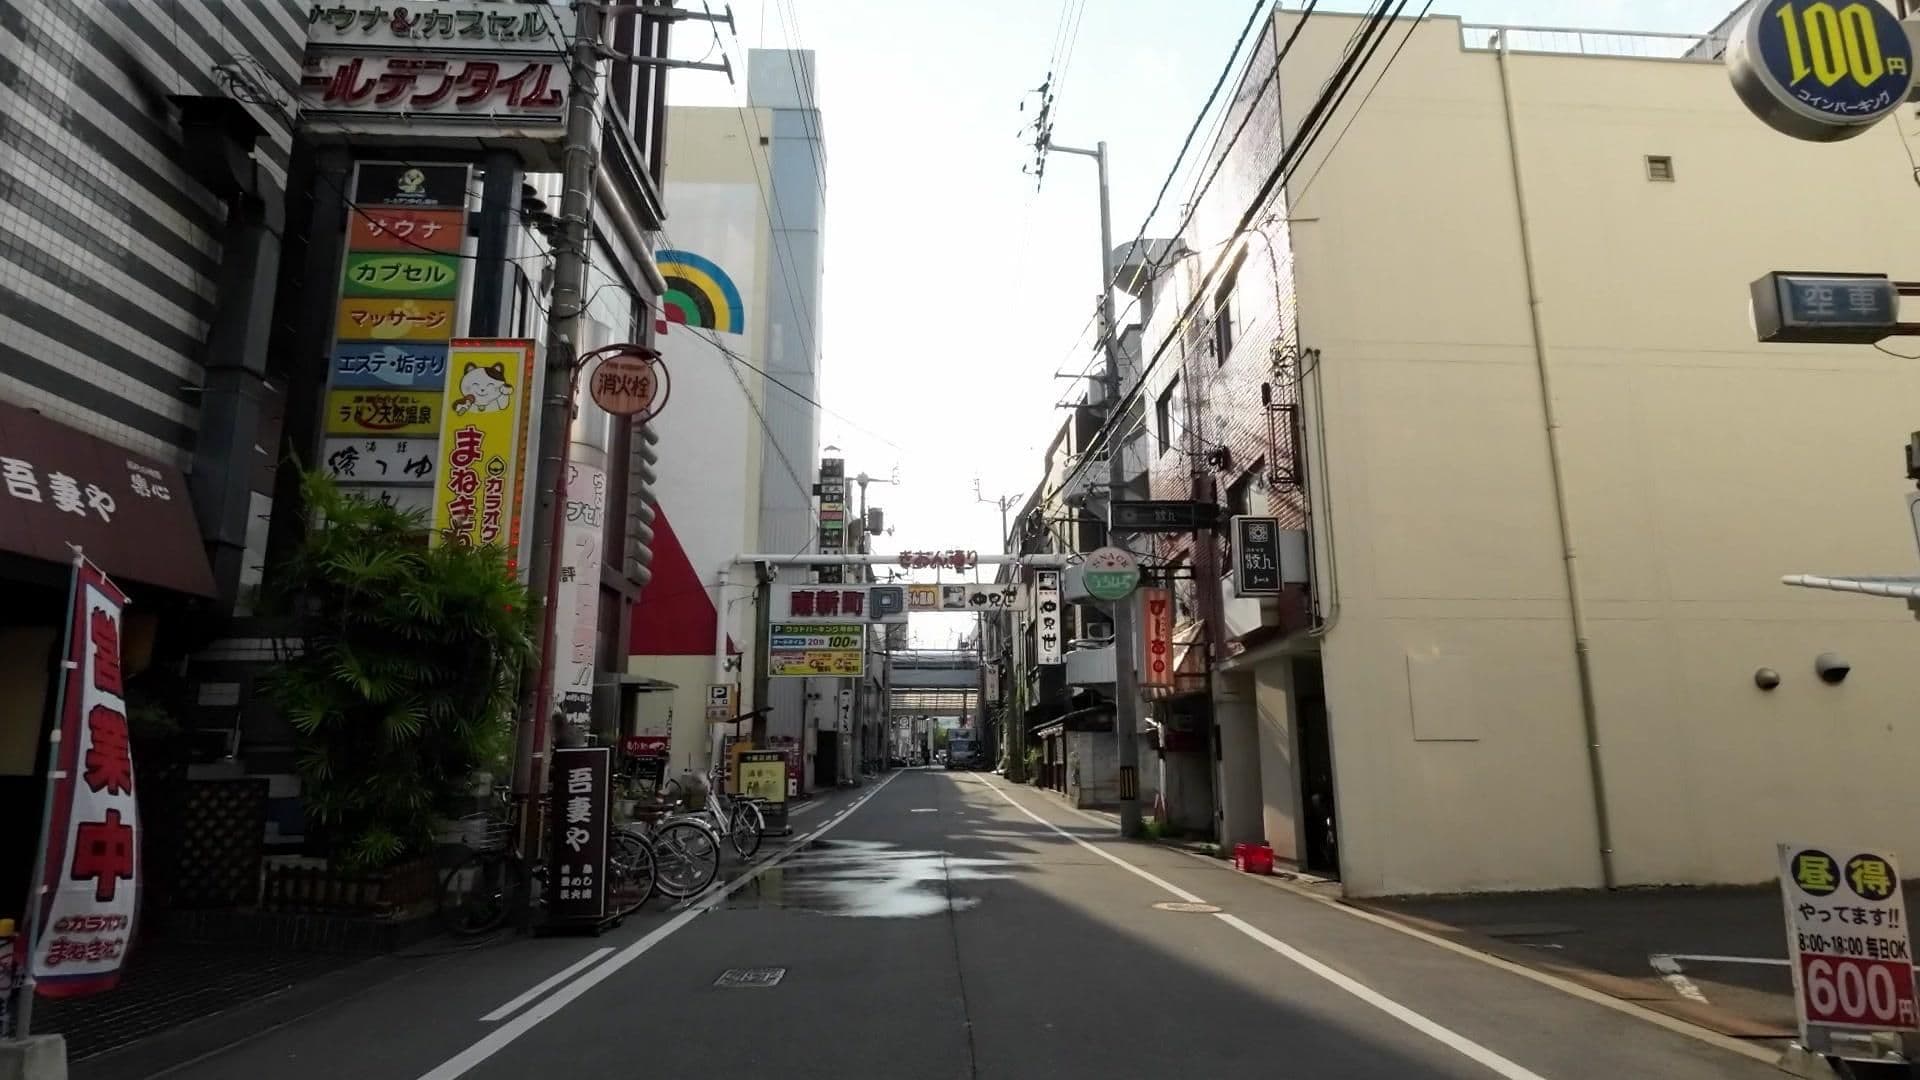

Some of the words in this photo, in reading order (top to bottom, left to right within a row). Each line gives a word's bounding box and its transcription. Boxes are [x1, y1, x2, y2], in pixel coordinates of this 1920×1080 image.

[301, 58, 564, 108] ールデンタイム
[367, 218, 443, 239] サウナ
[356, 262, 447, 284] カプセル
[1804, 286, 1880, 316] 空車
[350, 309, 447, 328] マッサージ
[597, 373, 651, 398] 消火栓
[482, 476, 504, 542] カラオケ
[713, 687, 725, 698] P
[71, 606, 134, 902] 営業中
[565, 767, 593, 852] 吾妻や
[1800, 903, 1900, 929] やってます!!
[1866, 935, 1909, 959] 毎日OK
